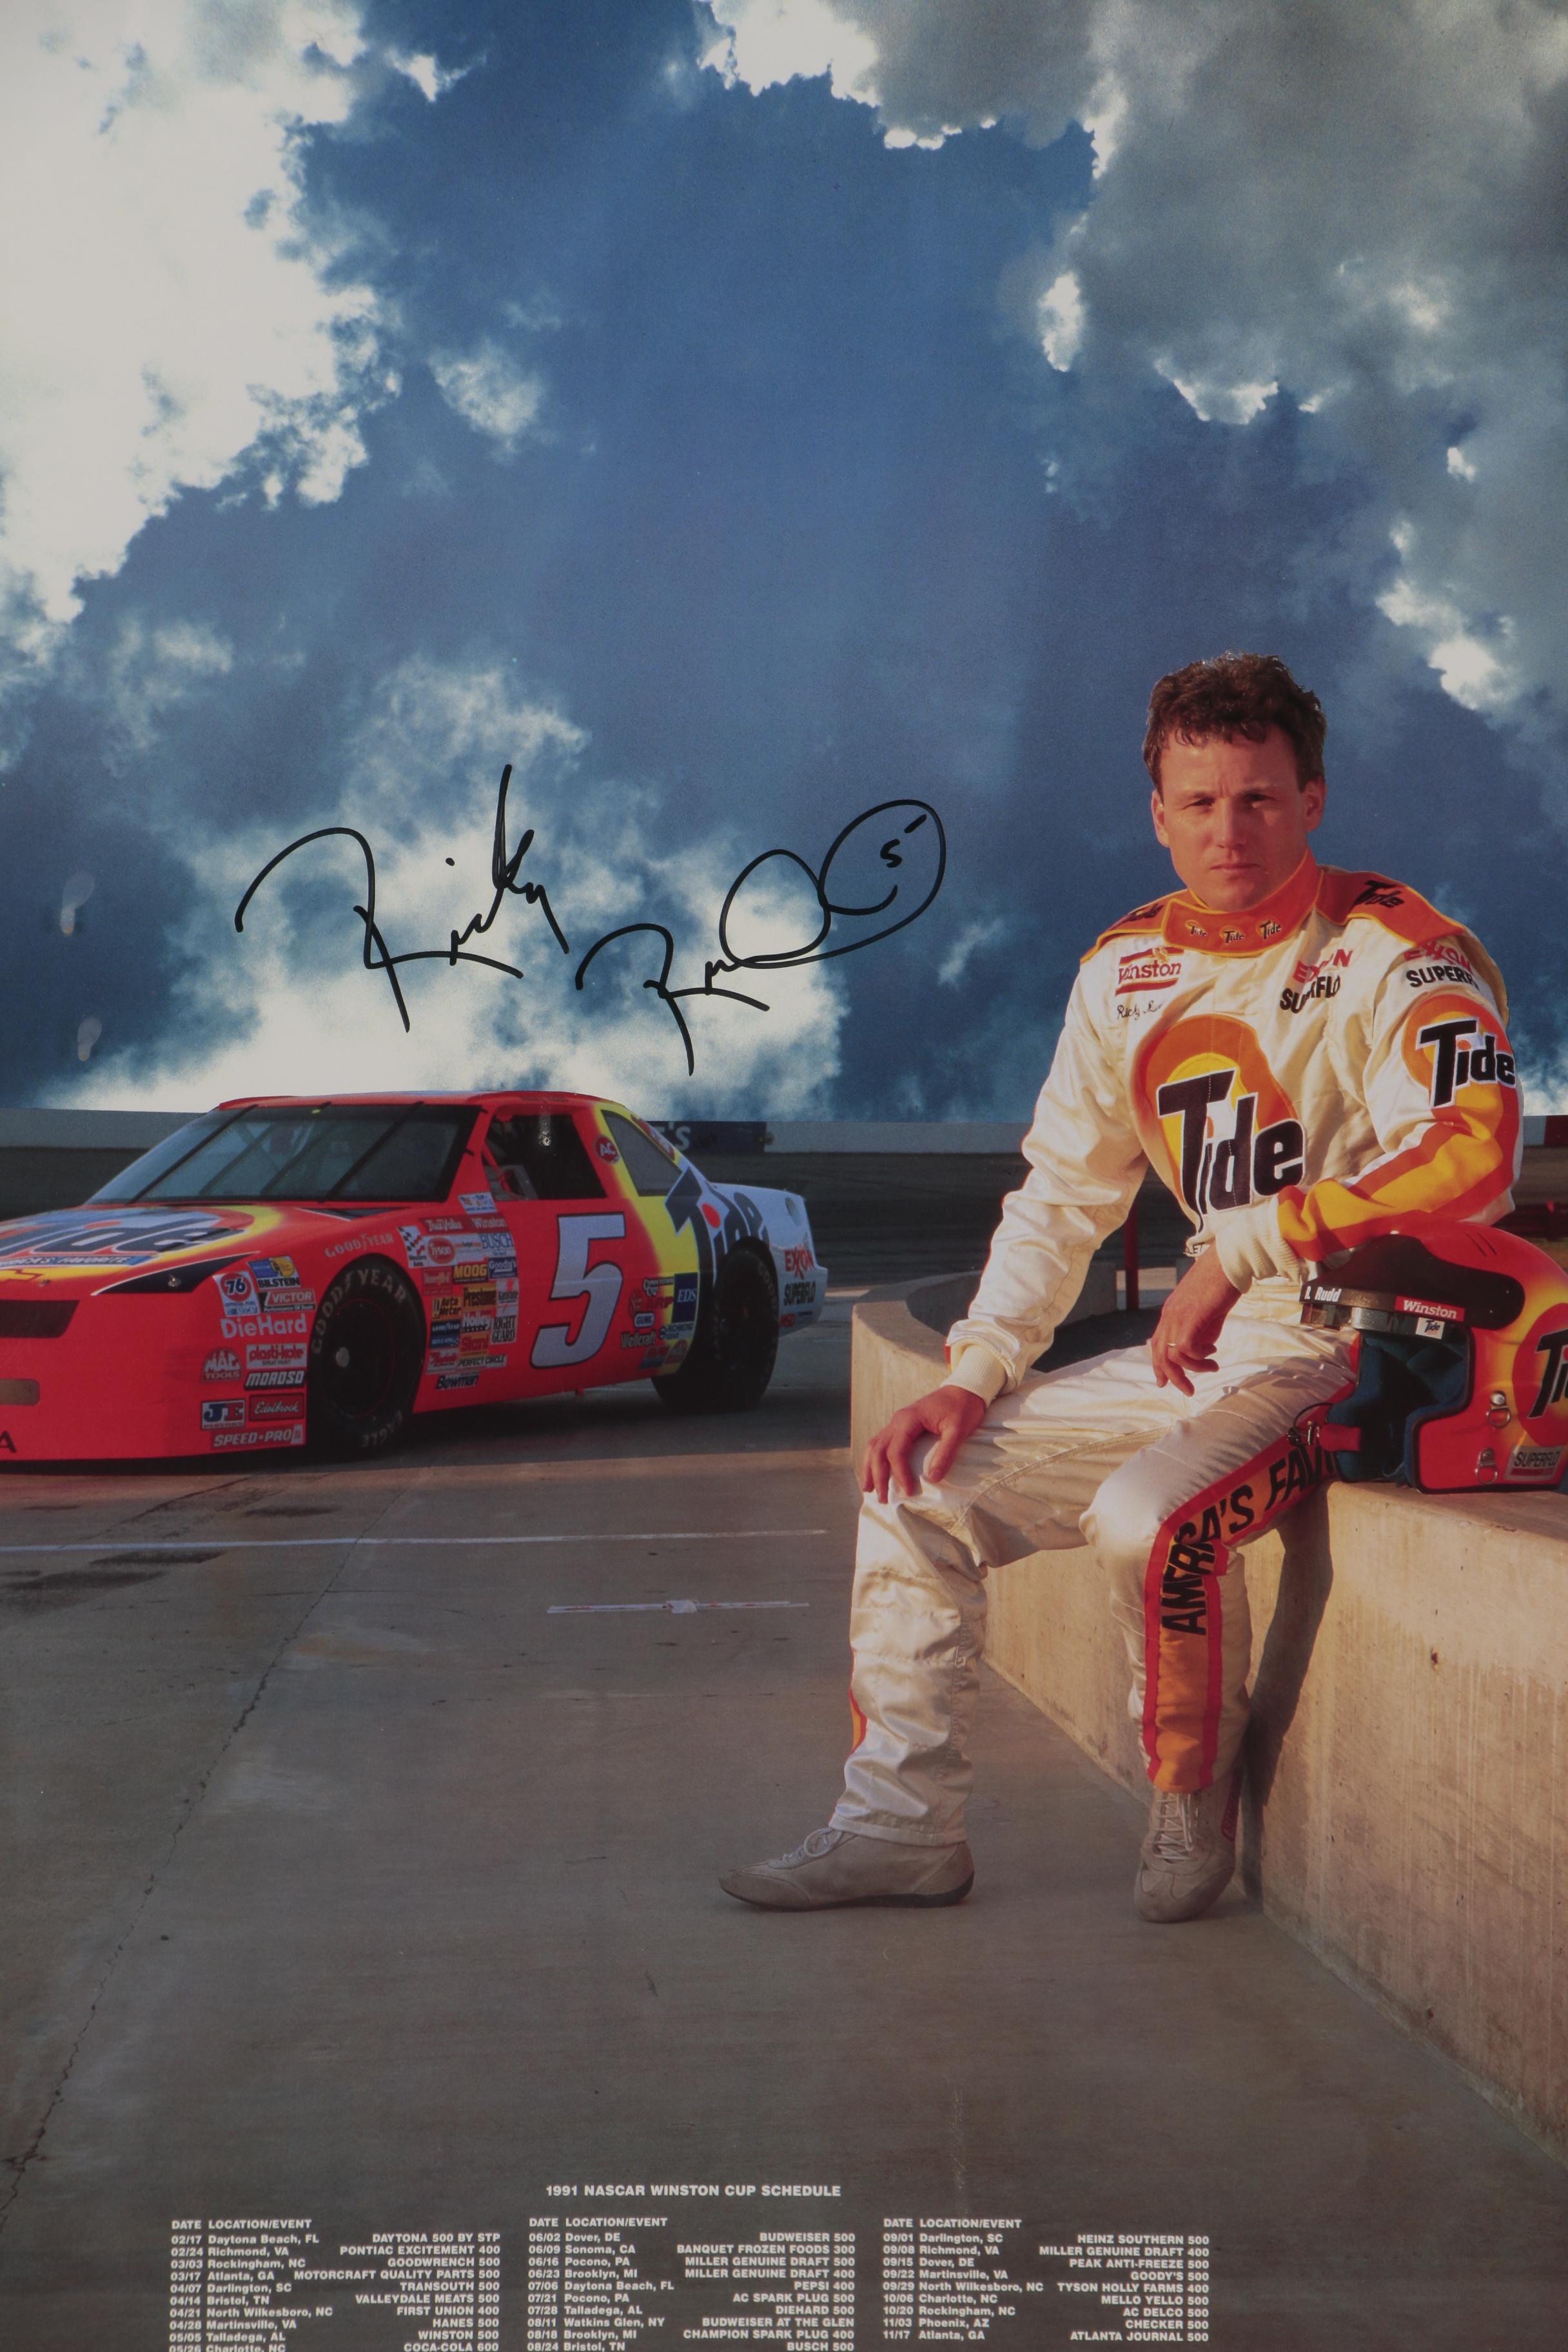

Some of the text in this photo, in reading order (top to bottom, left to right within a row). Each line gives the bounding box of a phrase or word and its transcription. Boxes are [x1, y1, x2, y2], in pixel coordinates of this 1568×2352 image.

[1259, 920, 1282, 940] Tide
[1223, 930, 1245, 944] Tide
[1415, 1015, 1516, 1109] Tide
[1157, 1067, 1306, 1233] Tide
[479, 1232, 514, 1250] BUSCH
[429, 1243, 452, 1257] Tyson
[453, 1264, 488, 1279] MOOG
[224, 1277, 247, 1295] 76
[258, 1277, 300, 1288] BILSTEIN
[529, 1211, 627, 1369] 5
[677, 1288, 697, 1303] EDS
[1314, 1286, 1342, 1302] Rudd
[272, 1291, 313, 1303] VICTOR
[1404, 1298, 1458, 1320] Winston
[220, 1311, 308, 1338] DieHard
[493, 1315, 516, 1330] RIGHT
[1423, 1318, 1442, 1333] Tide
[491, 1329, 516, 1344] GUARD
[204, 1349, 241, 1372] MAC
[206, 1371, 240, 1380] TOOLS
[245, 1370, 306, 1387] MOROSO
[253, 1401, 300, 1415] Edelbrock
[1514, 1450, 1561, 1469] SUPERFLO
[546, 2184, 841, 2197] 1991 NASCAR WINSTON CUP SCHEDULE
[172, 2219, 312, 2230] DATE LOCATION/EVENT
[529, 2217, 668, 2227] DATE LOCATION/EVENT
[883, 2218, 1022, 2229] DATE LOCATION/EVENT
[171, 2234, 320, 2248] 02/17 Daytona Beach, FL
[372, 2233, 501, 2243] DAYTONA 500 BY STP
[883, 2233, 1003, 2245] 09/01 Darlington, SC
[1077, 2234, 1210, 2245] HEINZ SOUTHERN 500
[528, 2244, 636, 2257] 06/09 Sonoma, CA
[676, 2244, 856, 2255] BANQUET FROZEN FOODS 300
[883, 2257, 975, 2269] 09/15 Dover, DE
[1069, 2258, 1210, 2269] PEAK ANTI-FREEZE 500
[170, 2270, 275, 2283] 03/17 Atlanta, GA
[294, 2269, 500, 2280] MOTORCRAFT QUALITY PARTS 500
[527, 2280, 674, 2293] 07/06 Daytona Beach, FL
[794, 2280, 855, 2291] PEPSI 400
[882, 2281, 1044, 2293] 09/29 North Wilkesboro, NC
[1057, 2282, 1210, 2293] TYSON HOLLY FARMS 400
[170, 2306, 333, 2320] 04/21 North Wilkesboro, NC
[397, 2306, 500, 2316] FIRST UNION 400
[527, 2317, 665, 2329] 08/11 Watkins Glen, NY
[702, 2317, 854, 2328] BUDWEISER AT THE GLEN
[883, 2329, 985, 2342] 11/17 Atlanta, GA
[1070, 2331, 1209, 2342] ATLANTA JOURNAL 500
